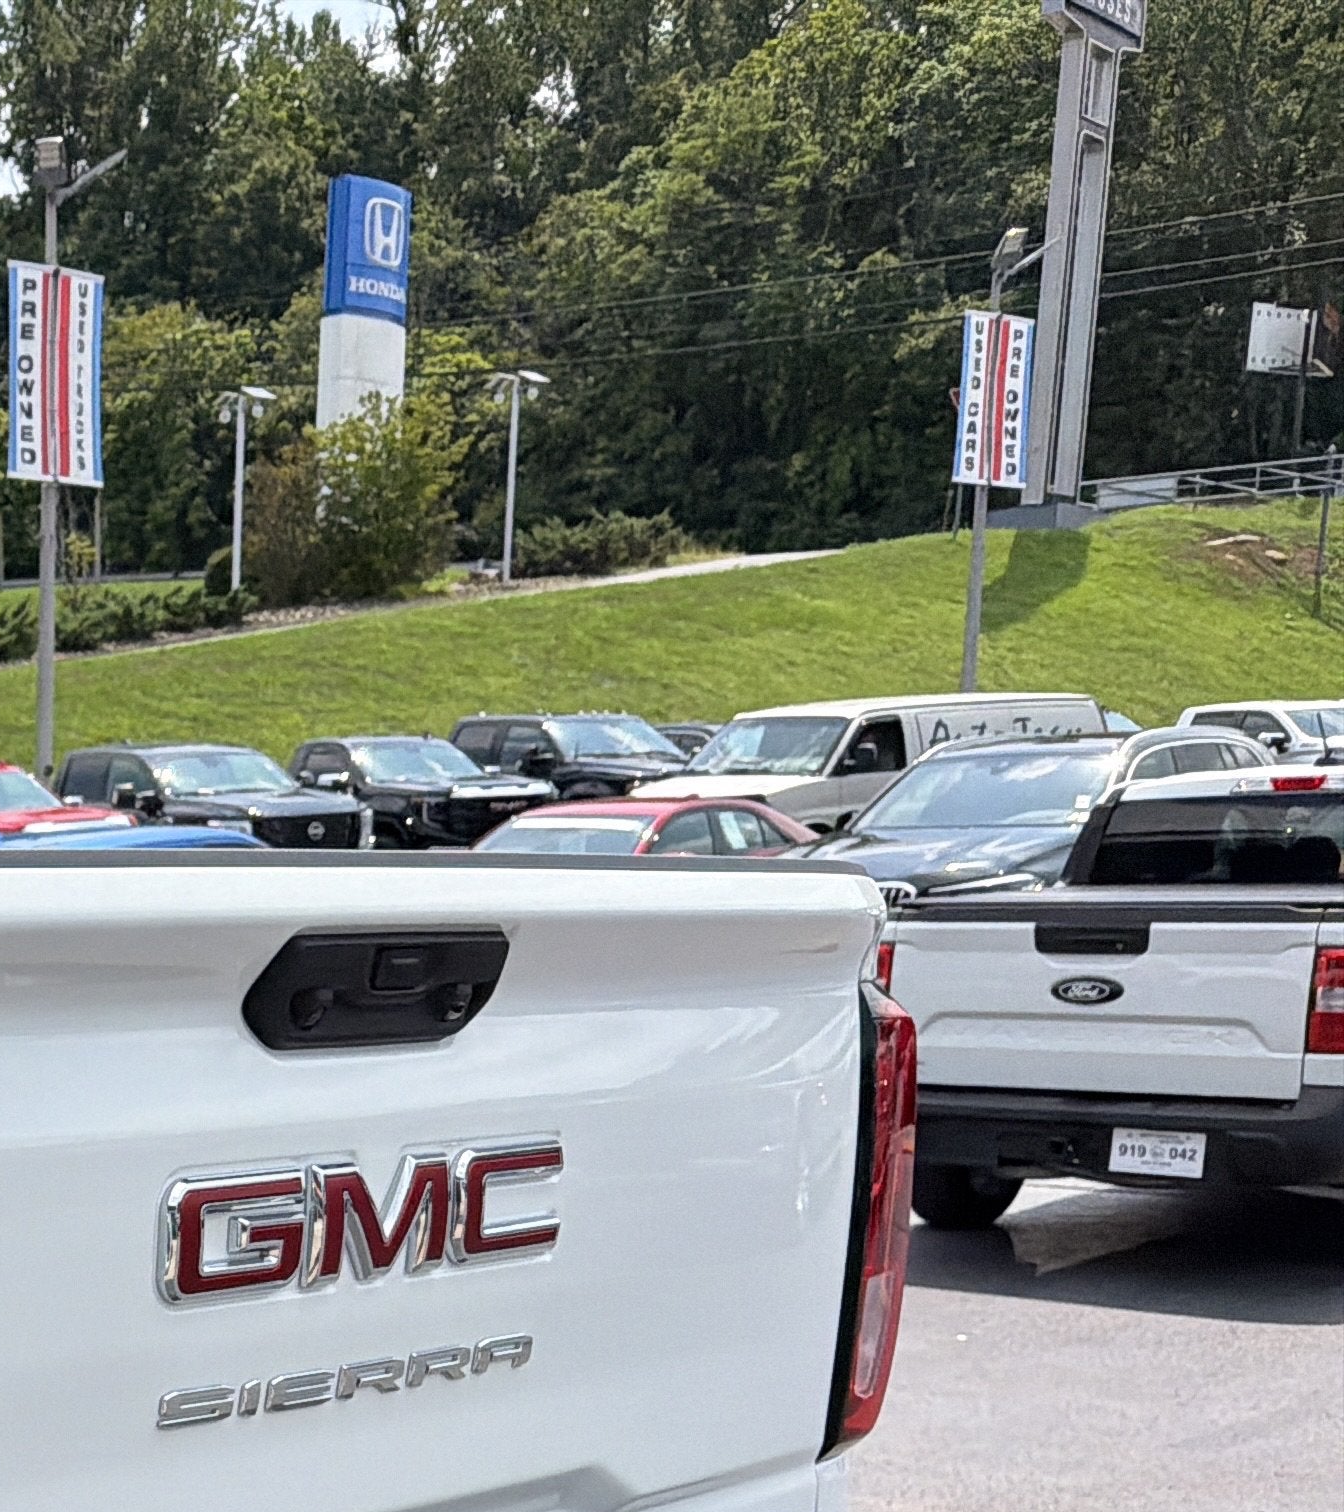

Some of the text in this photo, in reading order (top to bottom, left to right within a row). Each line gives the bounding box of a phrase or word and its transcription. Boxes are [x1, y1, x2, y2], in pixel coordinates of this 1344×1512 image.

[76, 282, 89, 354] USED
[348, 275, 407, 305] HONDA
[17, 278, 37, 466] PRE OWNED
[964, 320, 985, 472] USED CARS
[1004, 328, 1024, 476] PRE OWNED
[157, 1138, 564, 1303] GMC
[156, 1332, 534, 1430] SIERRA
